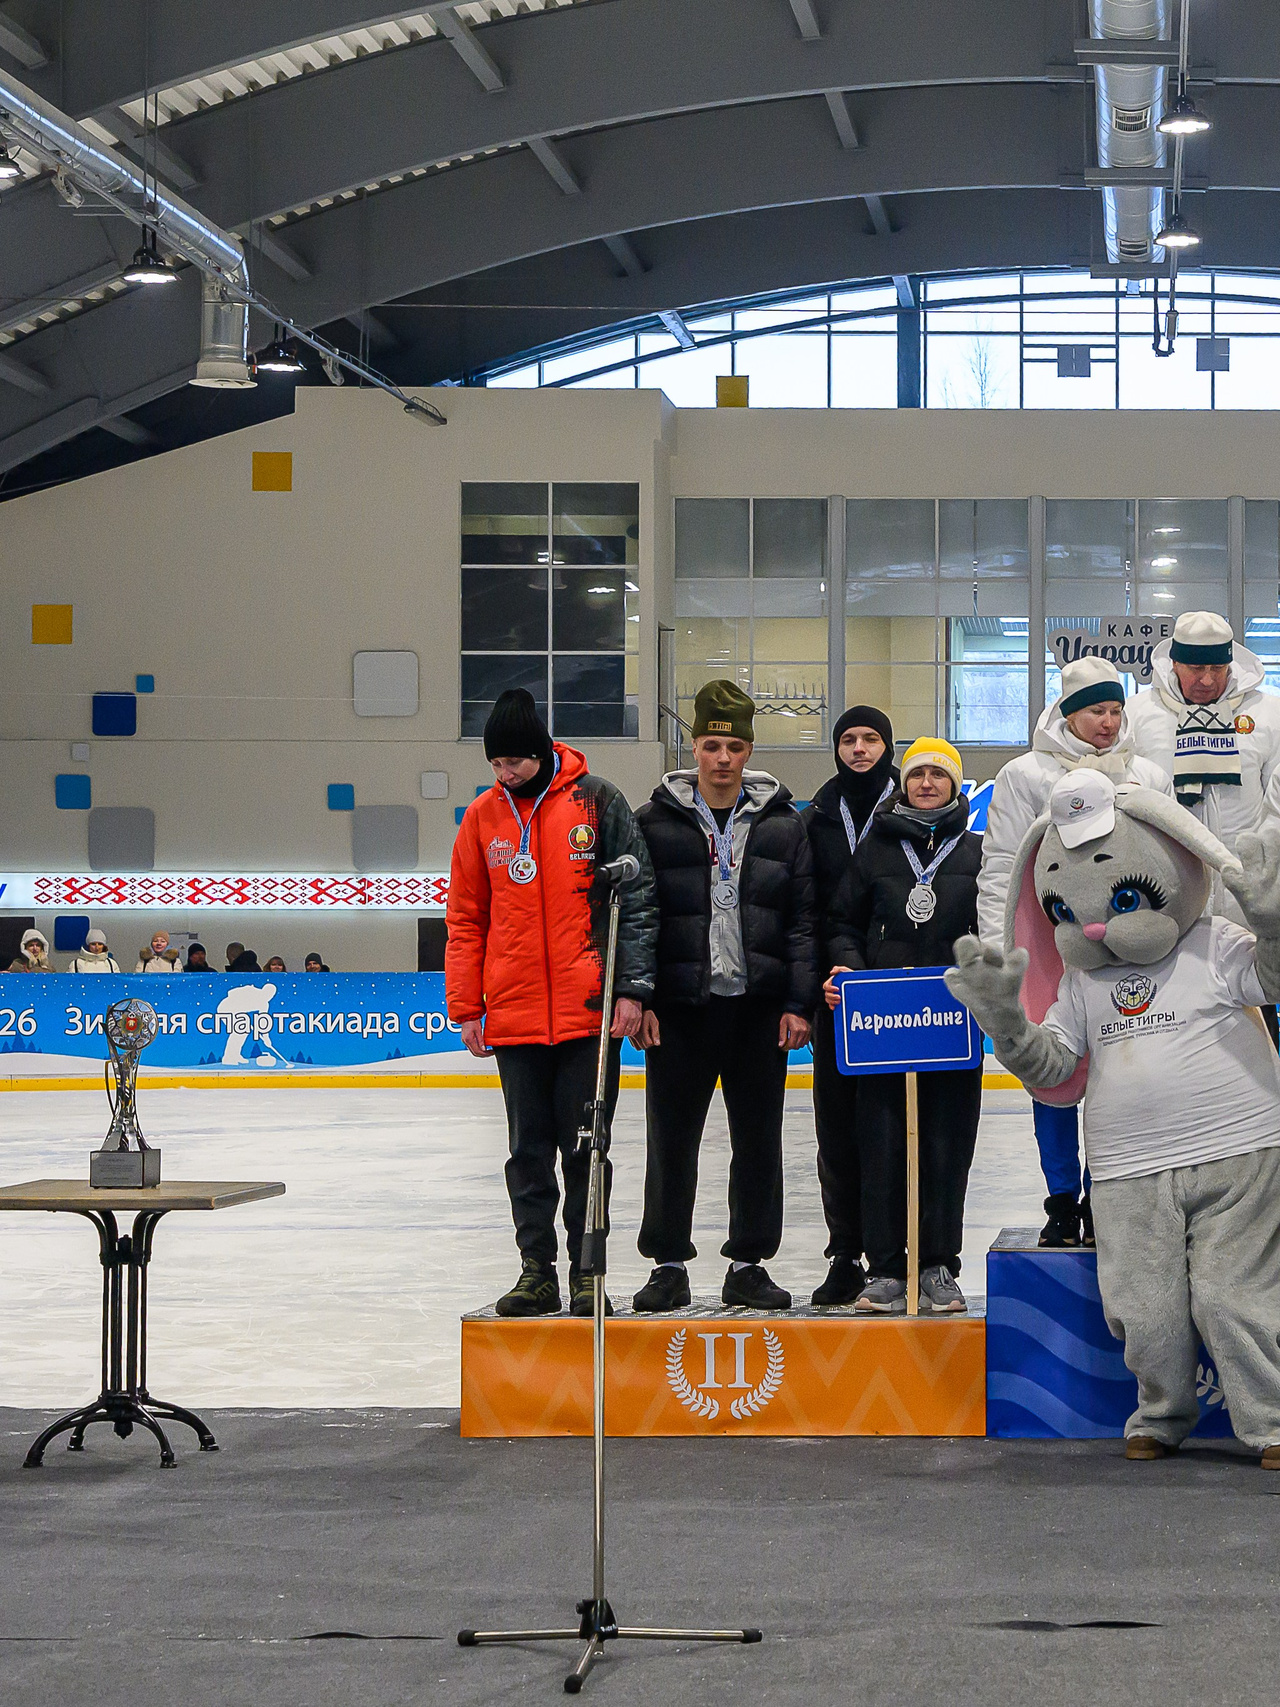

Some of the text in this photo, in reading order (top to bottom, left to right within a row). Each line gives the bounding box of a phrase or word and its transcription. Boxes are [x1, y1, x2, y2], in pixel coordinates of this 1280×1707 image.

[1107, 624, 1169, 637] КАФЕ
[1176, 736, 1235, 750] БЕЛЫЕ ТИГРЫ
[569, 852, 596, 861] BELARUS
[196, 1012, 400, 1041] спартакиада
[408, 1011, 463, 1040] сре
[850, 1006, 963, 1036] Агрохолдинг
[1101, 1011, 1175, 1035] БЕЛЫЕ ТИГРЫ
[697, 1333, 753, 1389] II
